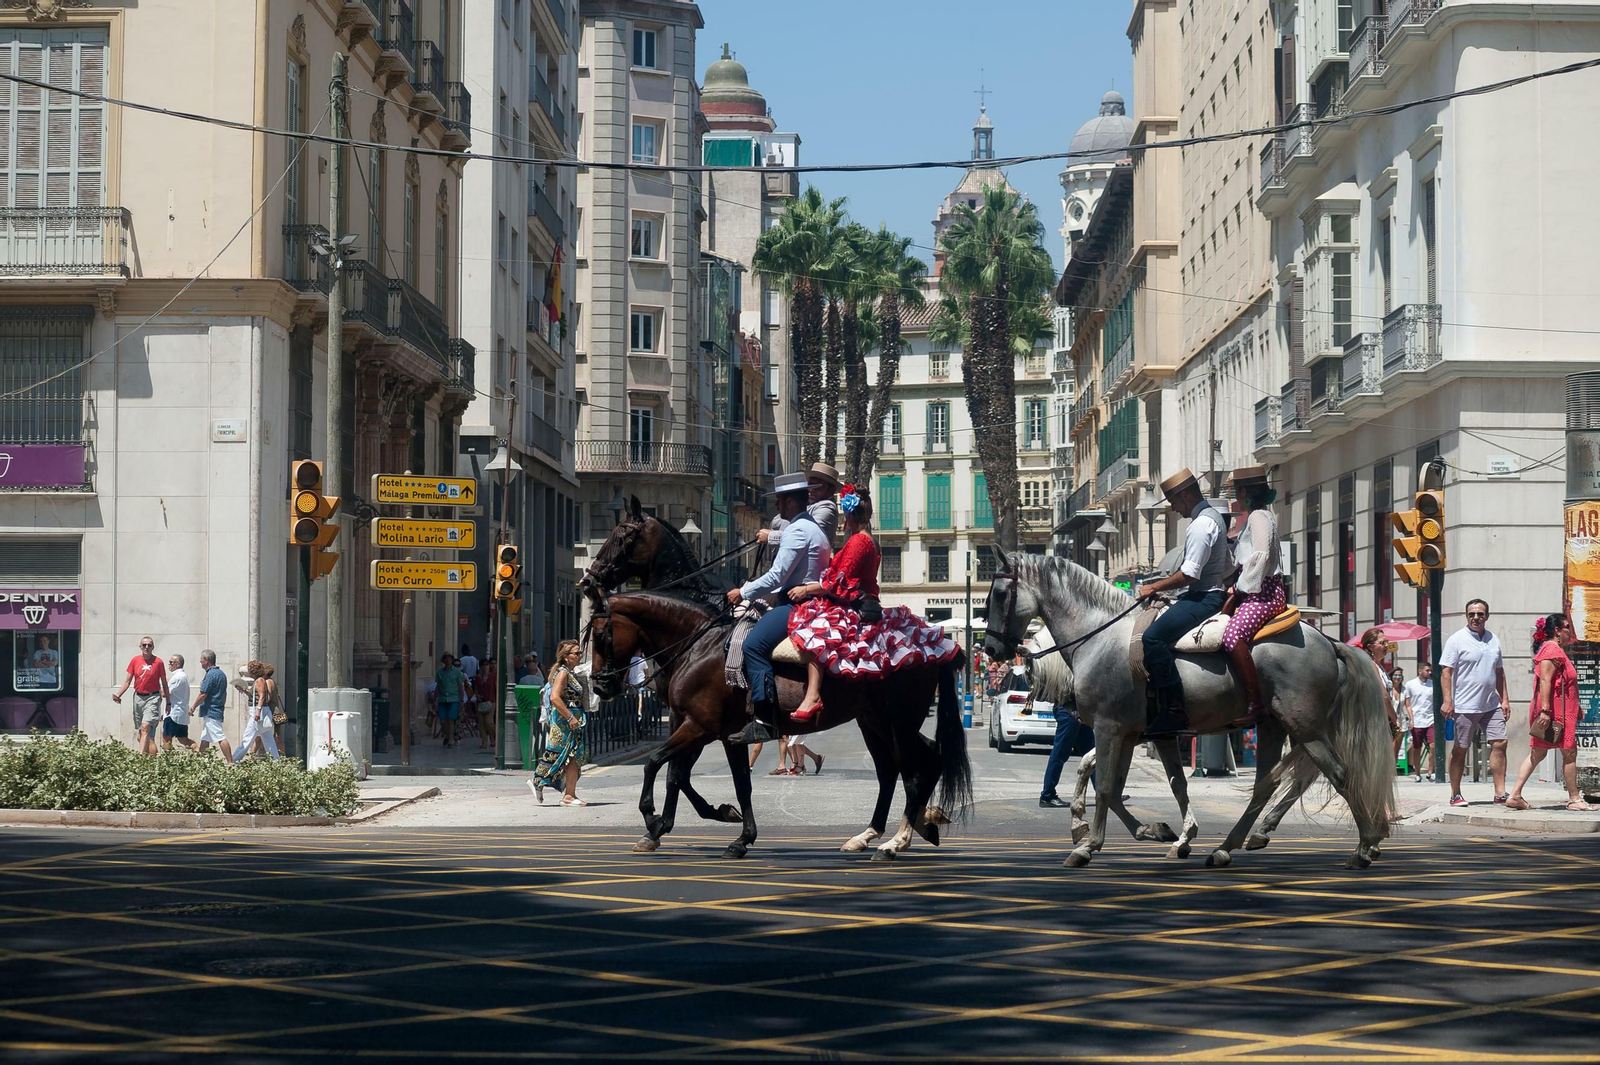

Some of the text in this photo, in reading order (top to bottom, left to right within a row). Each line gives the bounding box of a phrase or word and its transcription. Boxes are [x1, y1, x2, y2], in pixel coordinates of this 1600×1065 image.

[380, 489, 448, 500] Málaga Premium
[380, 533, 444, 543] Molina Lario
[379, 576, 432, 585] Don Curro
[0, 593, 76, 603] DENTIX
[17, 675, 40, 683] gratis
